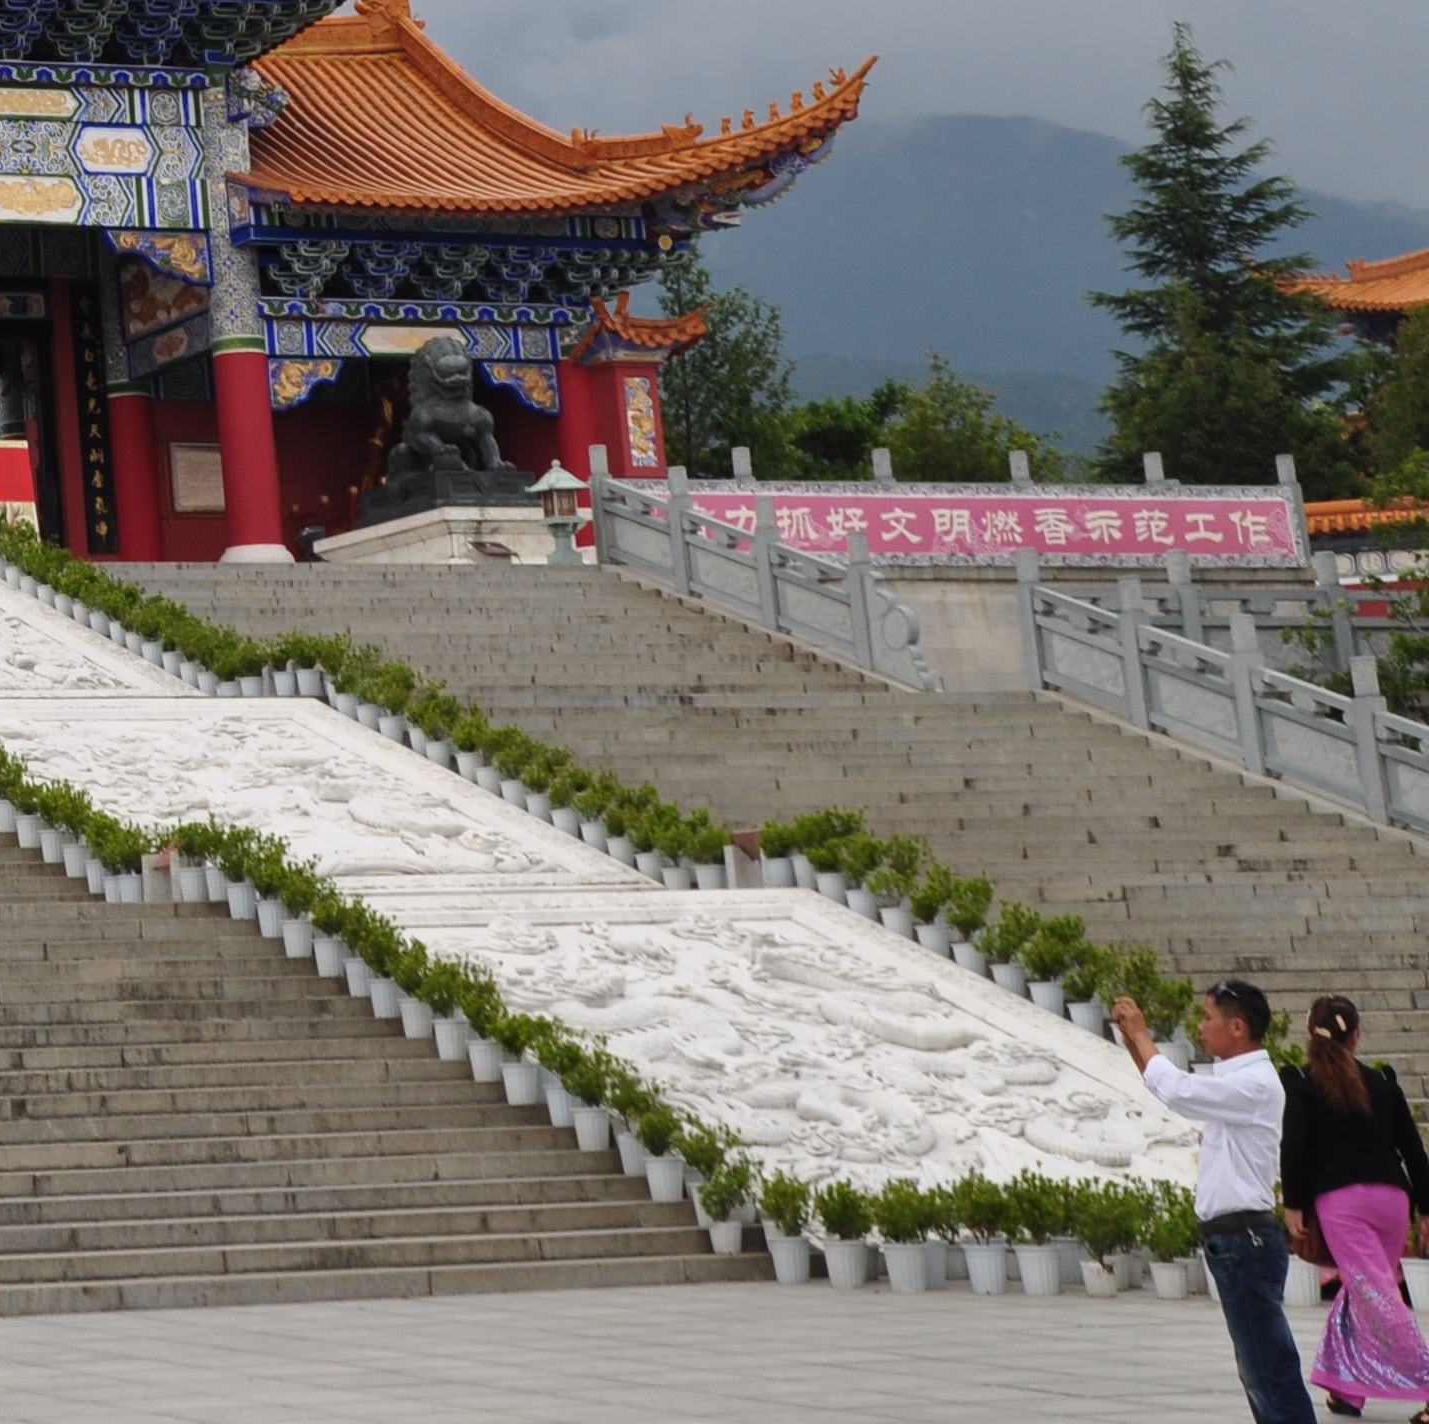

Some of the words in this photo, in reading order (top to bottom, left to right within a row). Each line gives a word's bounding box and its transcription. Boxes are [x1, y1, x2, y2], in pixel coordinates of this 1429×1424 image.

[692, 503, 1273, 546] 力抓好文明燃香示范工作
